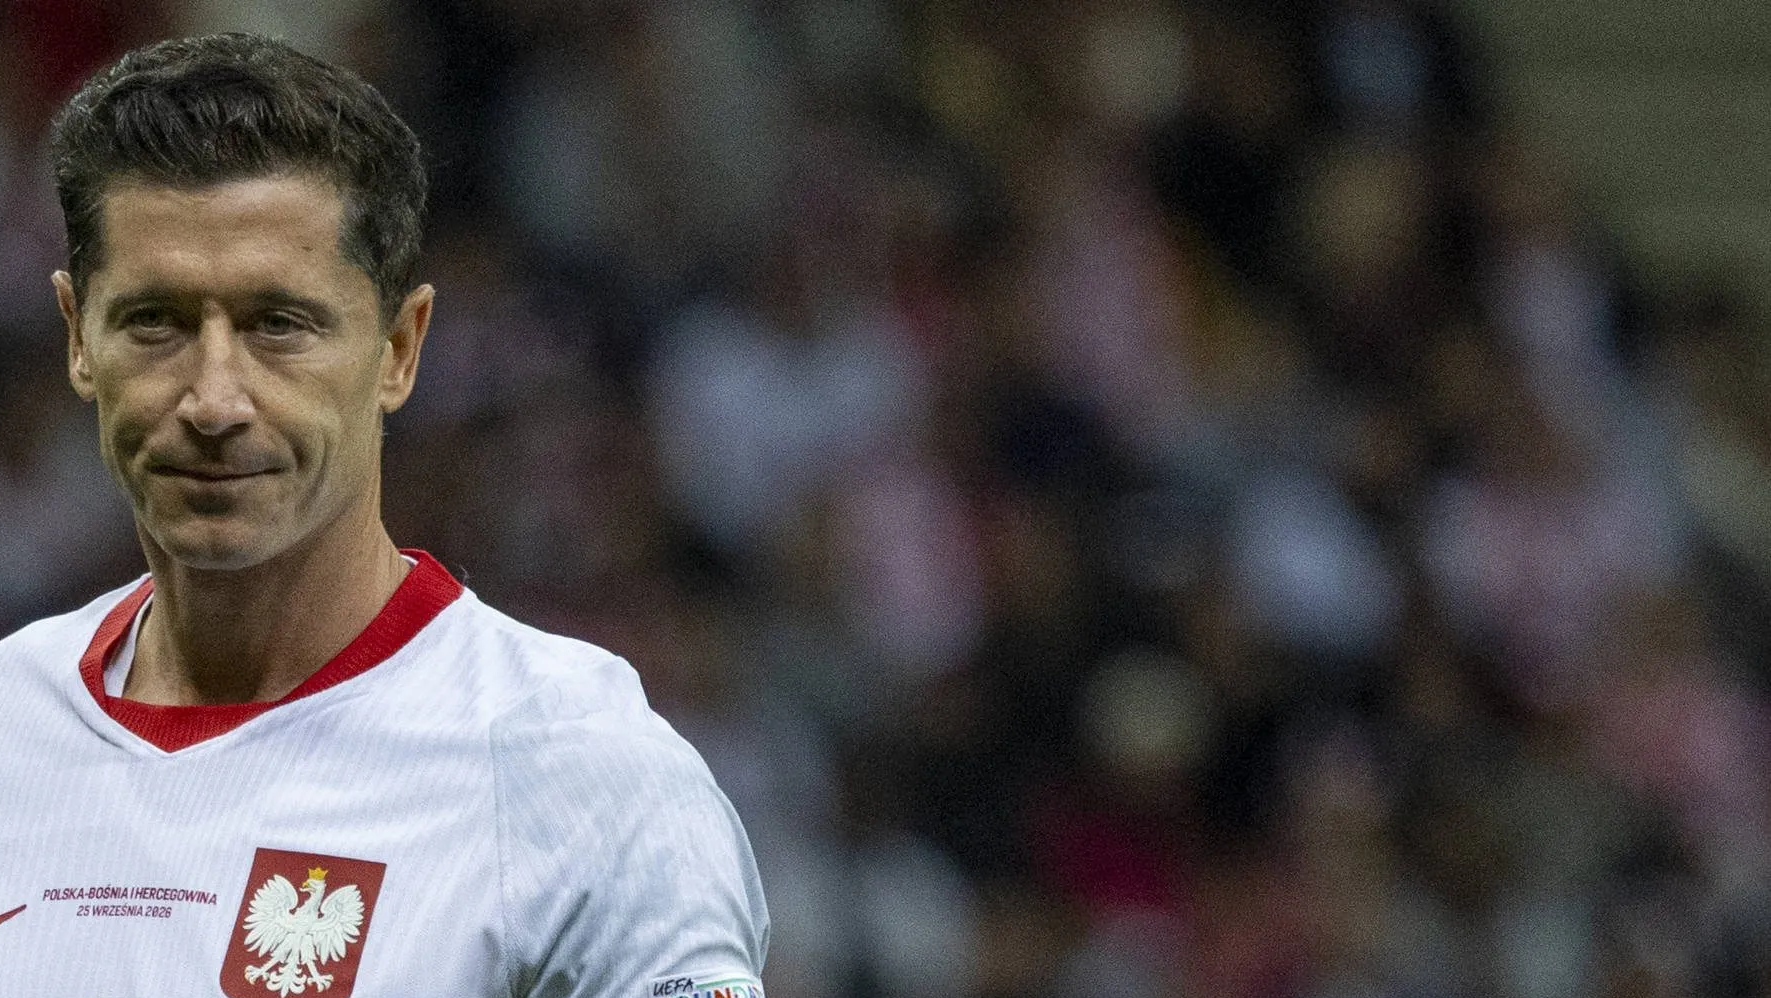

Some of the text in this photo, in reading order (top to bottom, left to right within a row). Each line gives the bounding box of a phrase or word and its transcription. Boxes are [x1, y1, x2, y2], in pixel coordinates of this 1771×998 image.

[135, 887, 217, 905] HERCEGOWINA
[76, 903, 172, 918] 25 WRZEŚNIA 2026
[653, 977, 694, 997] UEFA
